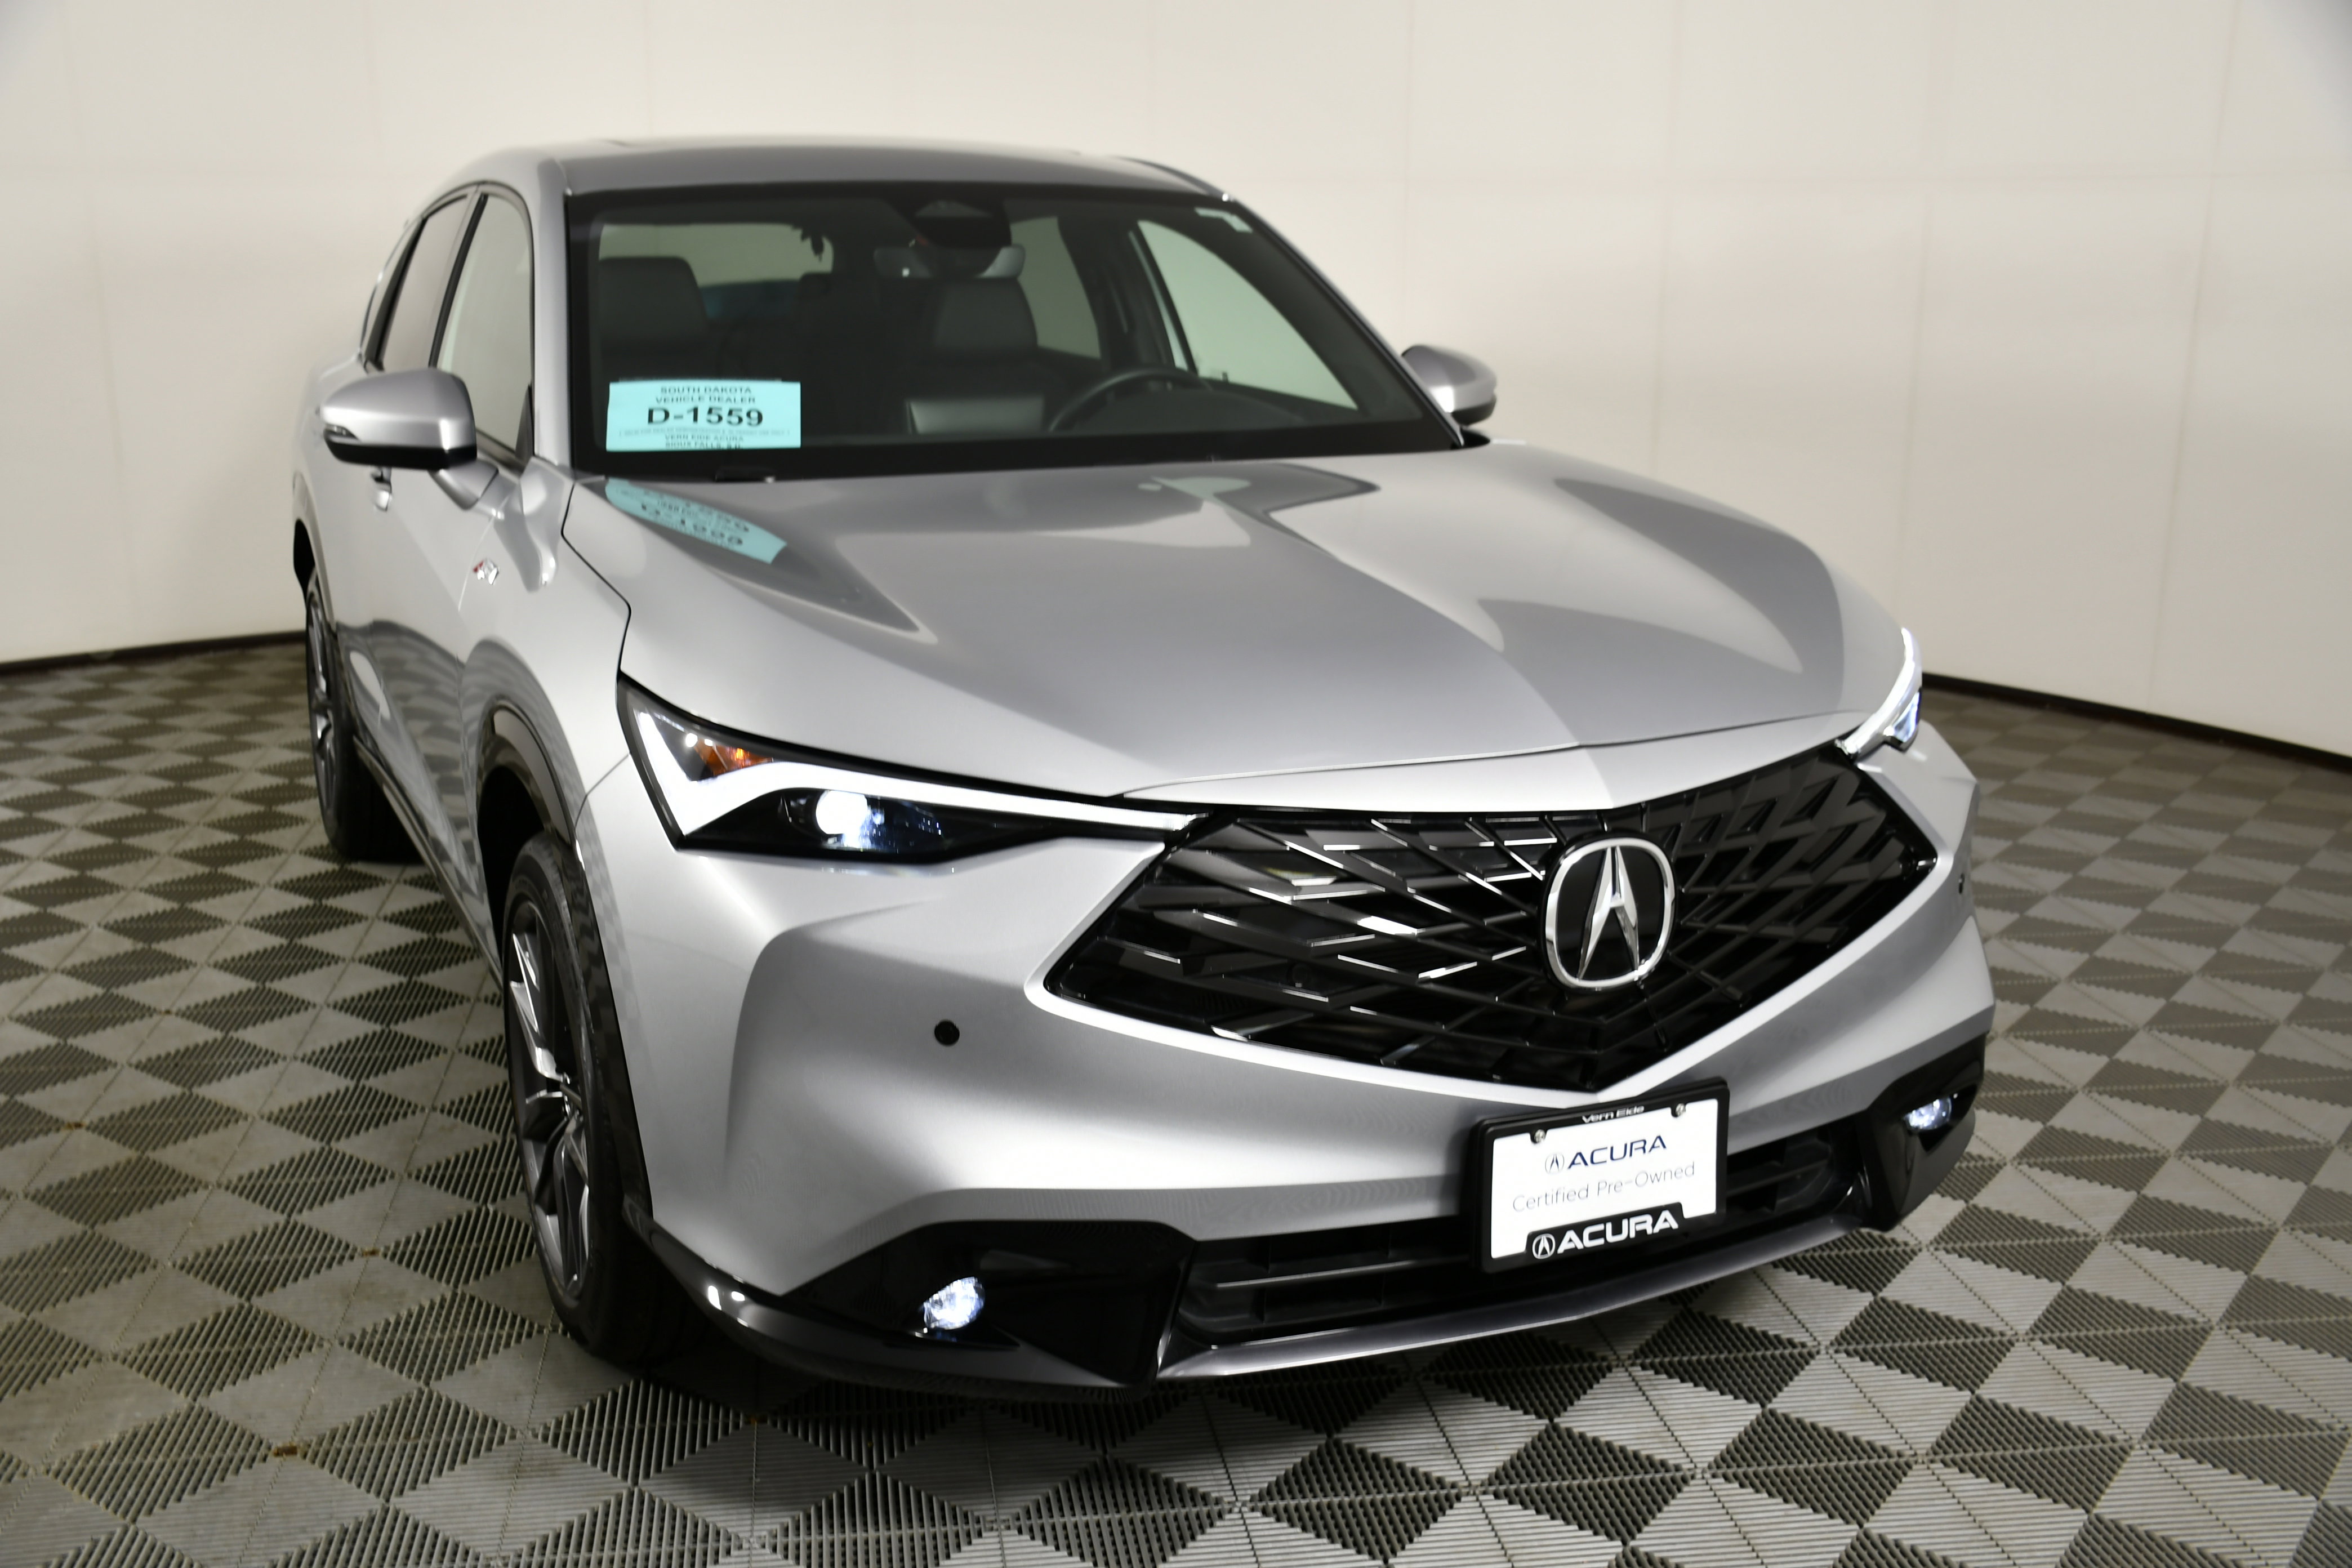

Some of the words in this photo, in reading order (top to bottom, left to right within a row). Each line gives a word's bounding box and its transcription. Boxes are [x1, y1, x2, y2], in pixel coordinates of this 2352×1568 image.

[656, 395, 704, 404] VEHICLE
[709, 395, 756, 404] DEALER
[647, 407, 763, 426] D-1559
[1582, 1111, 1614, 1124] Vern
[1616, 1105, 1645, 1118] Eide
[1567, 1135, 1667, 1170] ACURA
[1512, 1183, 1589, 1213] Certified
[1597, 1161, 1695, 1197] Pre-Owned
[1557, 1209, 1678, 1254] ACURA
